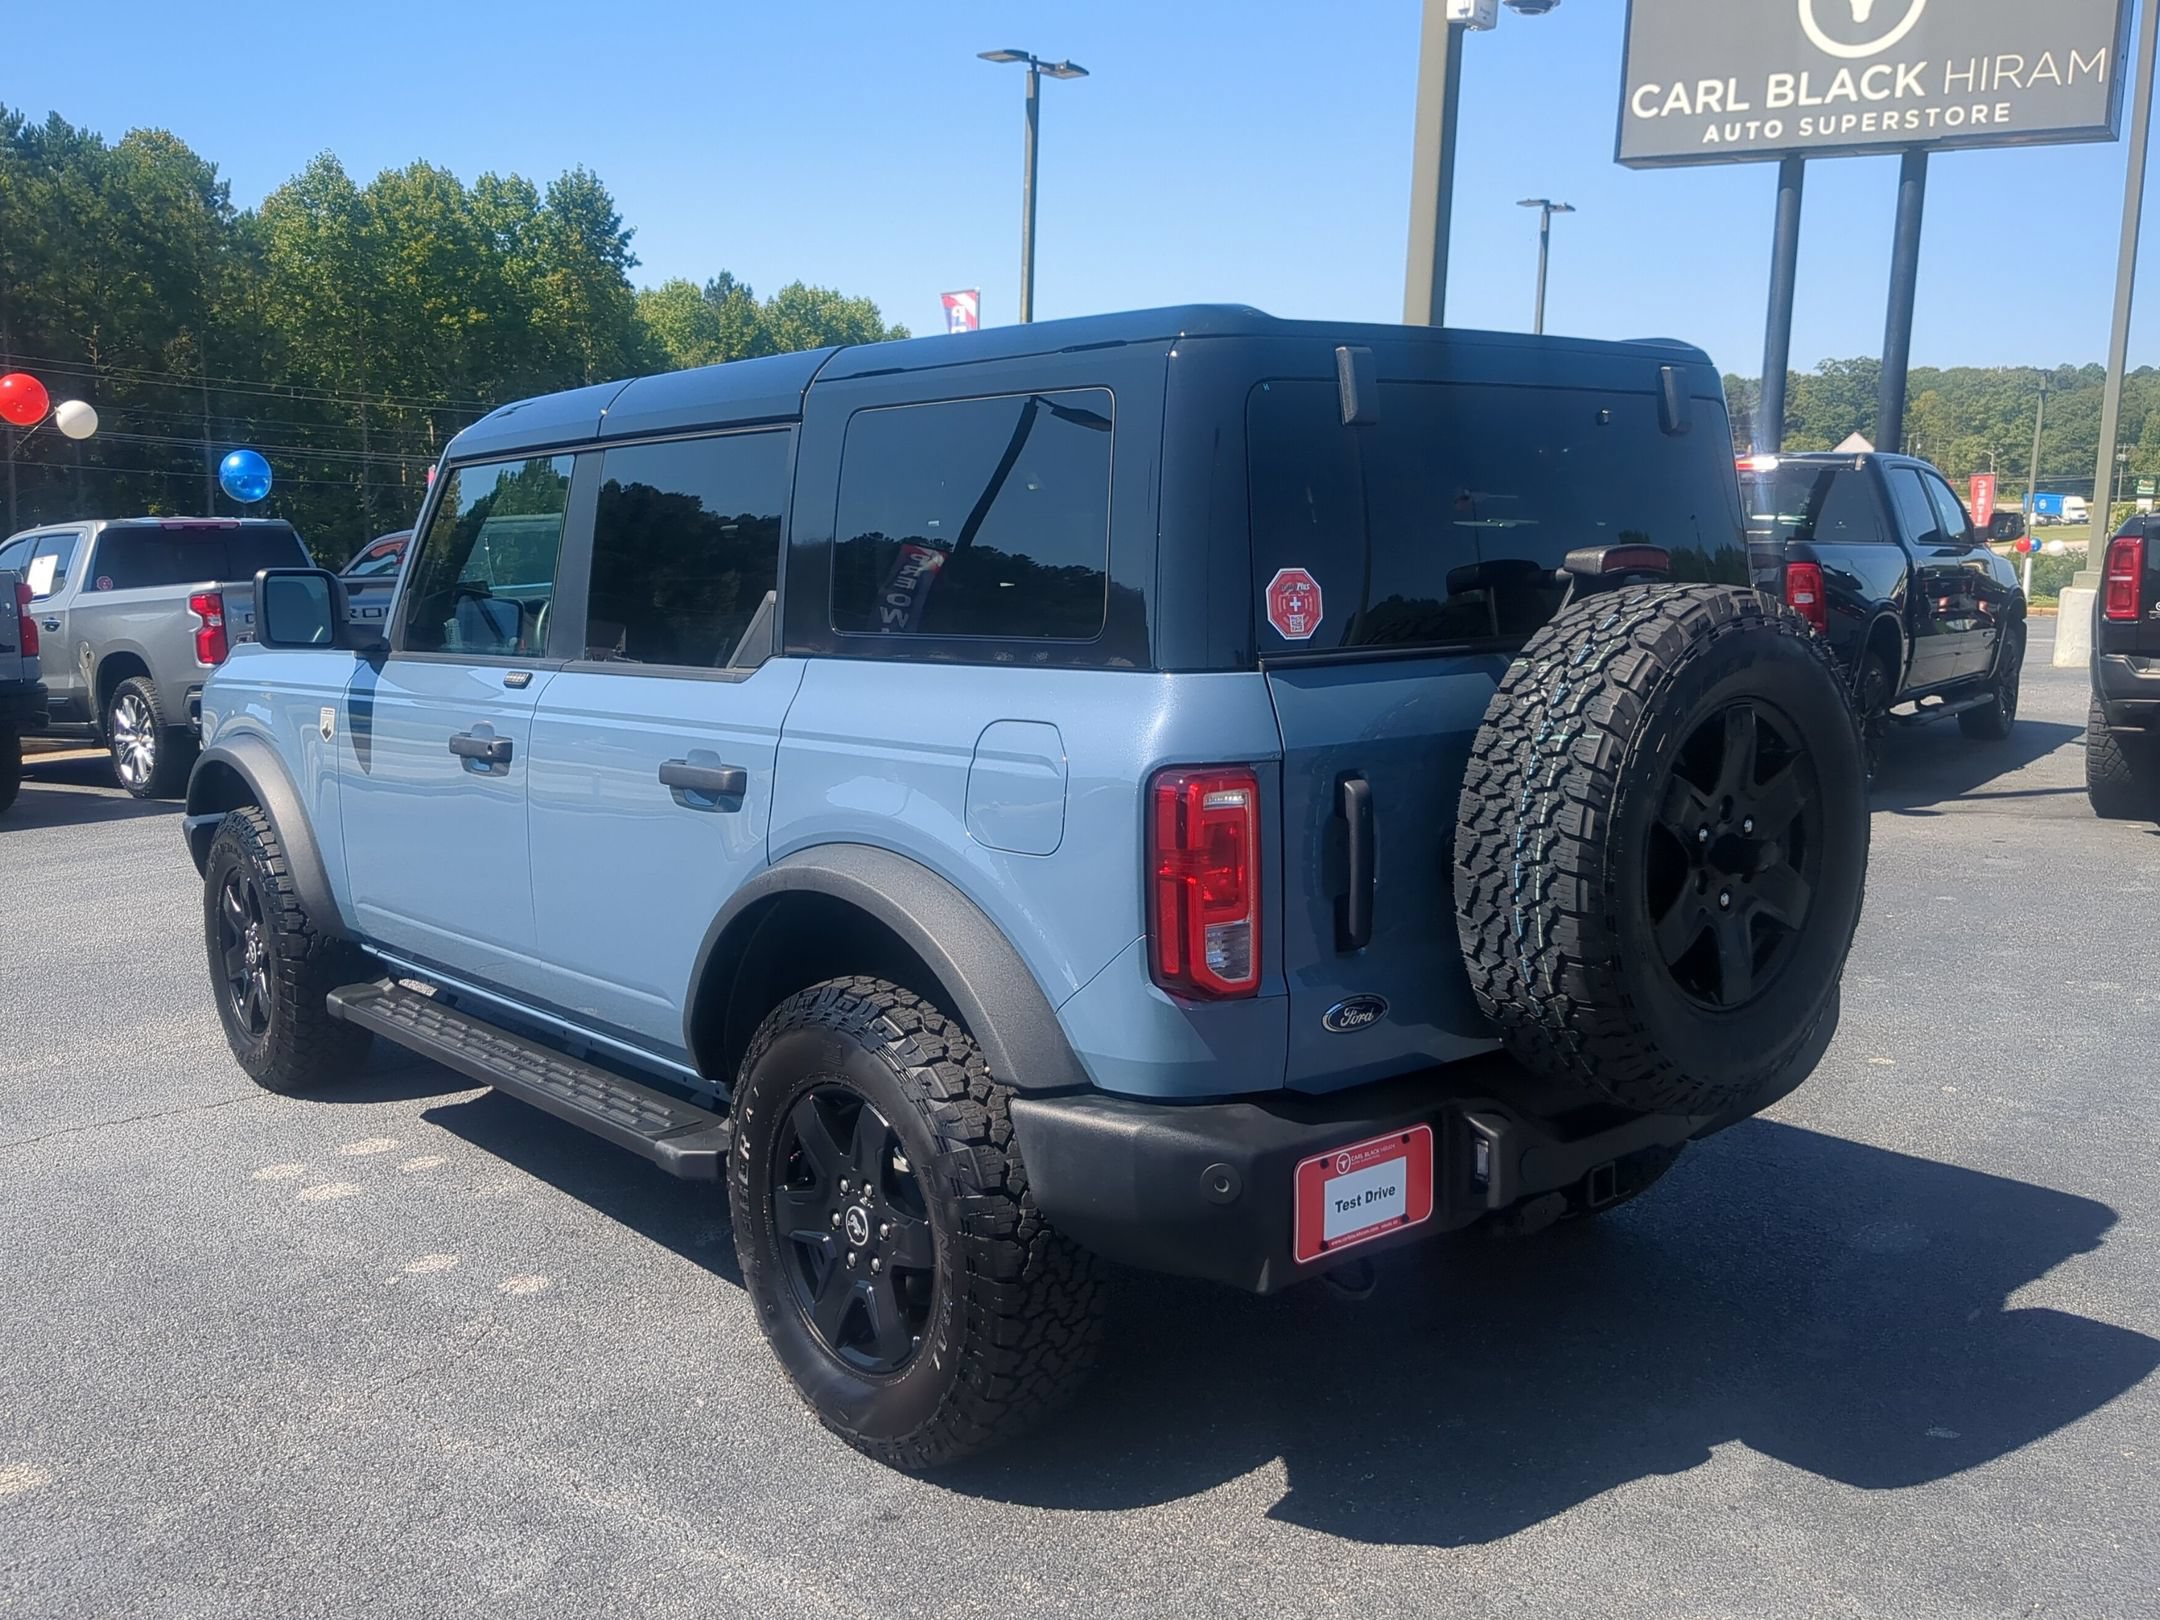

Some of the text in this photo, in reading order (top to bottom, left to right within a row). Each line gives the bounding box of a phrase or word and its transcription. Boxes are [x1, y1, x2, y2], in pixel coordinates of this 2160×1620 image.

[1631, 47, 2107, 118] CARL BLACK HIRAM
[1702, 102, 2011, 144] AUTO SUPERSTORE
[1339, 1005, 1375, 1027] Ford
[1335, 1186, 1396, 1213] Test Drive
